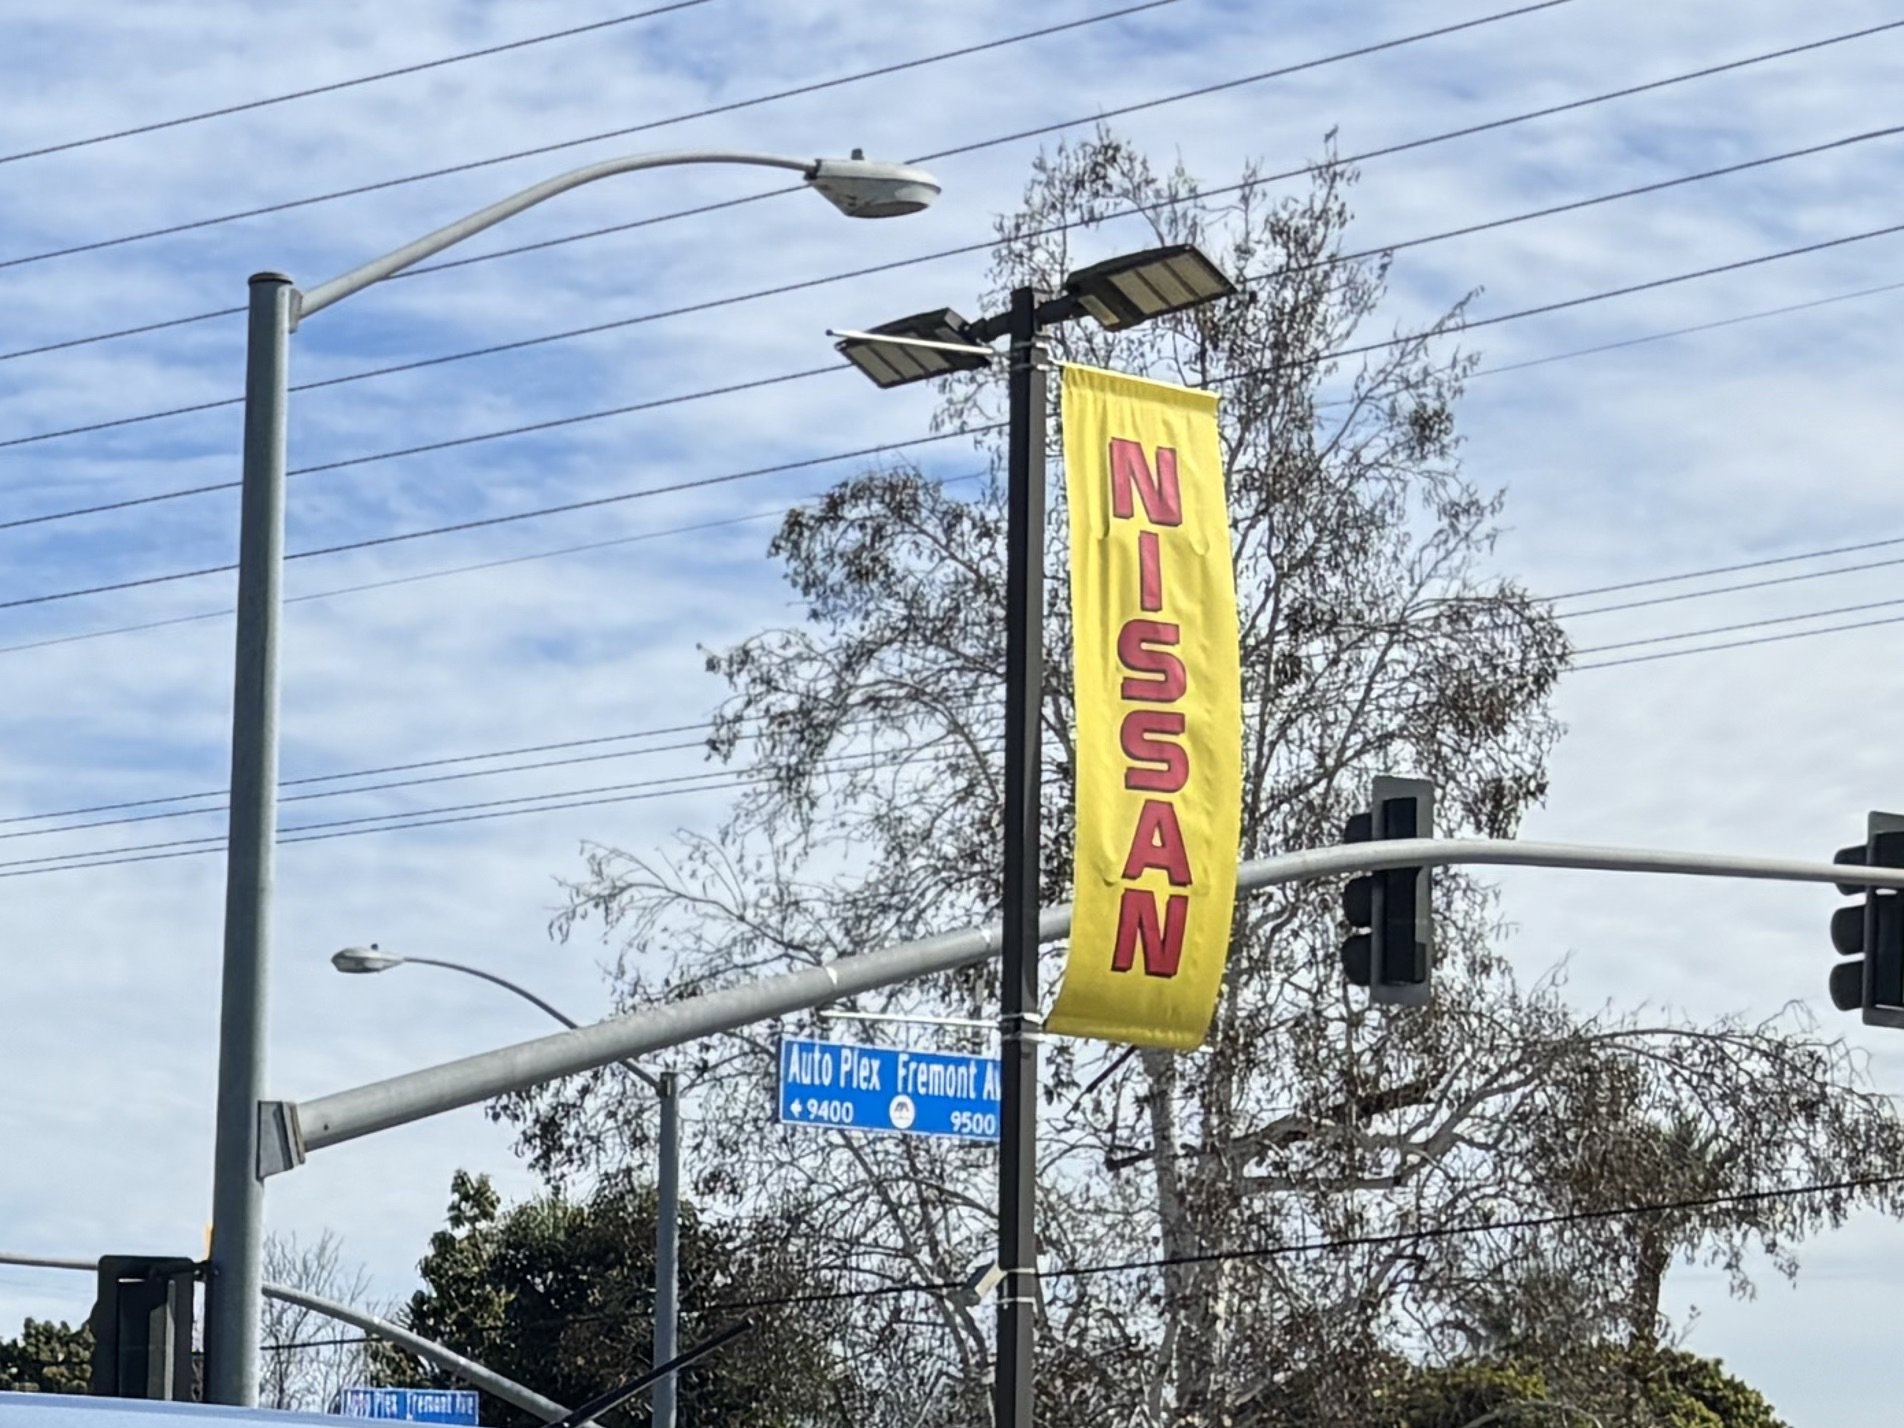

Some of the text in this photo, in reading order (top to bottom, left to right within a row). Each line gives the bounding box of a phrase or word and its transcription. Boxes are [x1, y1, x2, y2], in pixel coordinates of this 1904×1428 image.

[1109, 436, 1191, 980] NISSAN
[788, 1043, 833, 1086] Auto
[839, 1047, 881, 1091] Plex
[897, 1053, 977, 1099] Fremont
[806, 1098, 997, 1135] 9400 9500
